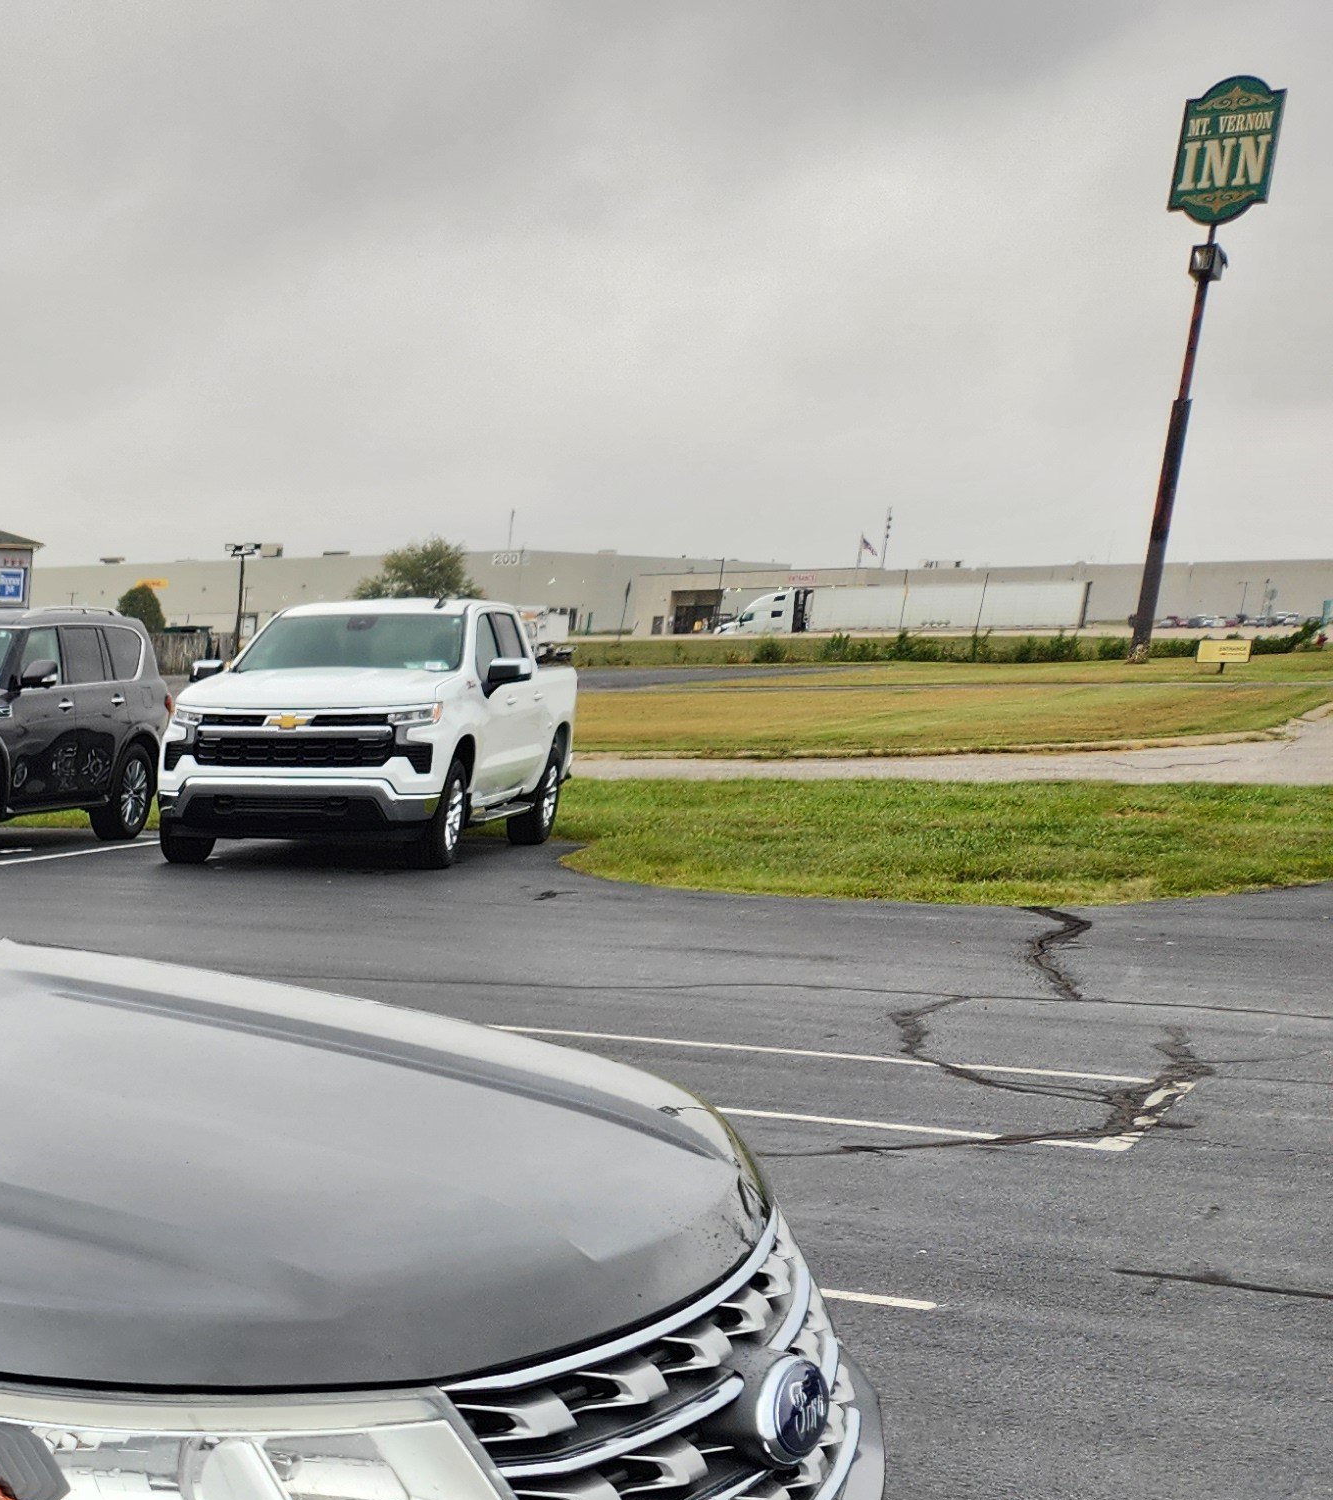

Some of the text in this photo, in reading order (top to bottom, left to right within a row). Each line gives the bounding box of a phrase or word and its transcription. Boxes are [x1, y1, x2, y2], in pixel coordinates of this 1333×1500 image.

[1188, 111, 1274, 137] MT. VERNON
[1177, 134, 1272, 191] INN
[492, 552, 520, 566] 200
